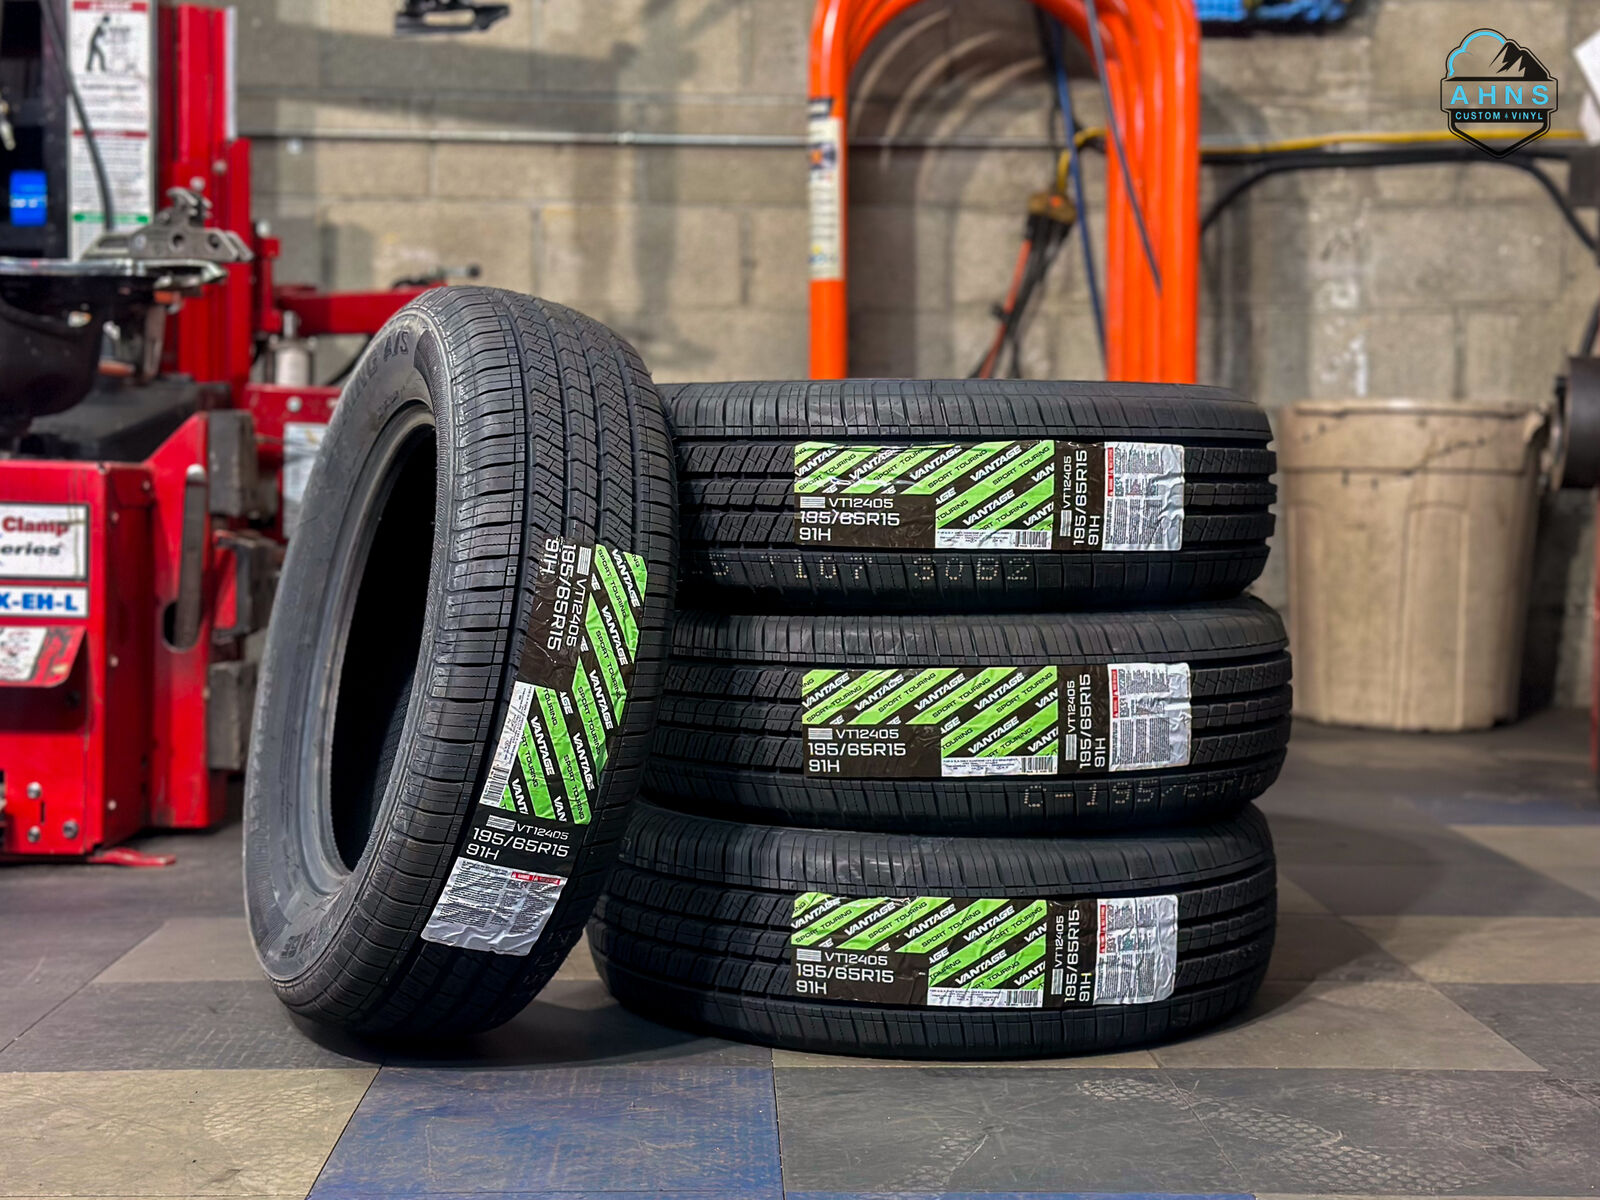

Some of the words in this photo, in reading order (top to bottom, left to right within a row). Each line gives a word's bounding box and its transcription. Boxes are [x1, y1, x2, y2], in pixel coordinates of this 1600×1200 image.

[799, 475, 823, 491] SPORT
[824, 453, 856, 475] TOURING
[873, 464, 898, 481] SPORT
[910, 445, 962, 480] VANTAGE
[928, 471, 953, 488] SPORT
[955, 449, 987, 471] TOURING
[970, 445, 1022, 482] VANTAGE
[993, 468, 1017, 485] SPORT
[1019, 446, 1050, 468] TOURING
[1063, 455, 1072, 509] VT12405
[1073, 450, 1088, 546] 195/65R15
[800, 510, 900, 526] 195/65R15
[828, 498, 893, 508] VT12405
[936, 499, 969, 521] TOURING
[962, 489, 1015, 526] VANTAGE
[995, 500, 1029, 523] TOURING
[2, 517, 69, 536] Clamp
[800, 528, 831, 541] 91H
[1088, 515, 1100, 545] 91H
[543, 538, 559, 575] 91H
[597, 549, 612, 577] SPORT
[610, 581, 628, 619] TOURING
[612, 549, 640, 607] VANTAGE
[547, 544, 576, 651] 195/65R15
[566, 579, 587, 647] VT12405
[595, 630, 609, 659] SPORT
[601, 605, 628, 665] VANTAGE
[578, 686, 590, 715] SPORT
[589, 669, 614, 730] VANTAGE
[802, 672, 850, 708] VANTAGE
[854, 674, 904, 711] VANTAGE
[878, 695, 902, 713] SPORT
[904, 673, 936, 695] TOURING
[914, 673, 966, 710] VANTAGE
[932, 700, 957, 718] SPORT
[958, 678, 990, 700] TOURING
[974, 672, 1025, 710] VANTAGE
[996, 695, 1020, 713] SPORT
[1022, 672, 1053, 695] TOURING
[1067, 681, 1076, 733] VT12405
[806, 707, 828, 722] SPORT
[1079, 674, 1092, 769] 195/65R15
[530, 715, 556, 776] VANTAGE
[808, 743, 906, 756] 195/65R15
[836, 729, 899, 739] VT12405
[941, 728, 974, 750] TOURING
[968, 716, 1019, 754] VANTAGE
[525, 751, 539, 788] TOURING
[563, 754, 576, 782] SPORT
[572, 732, 595, 791] VANTAGE
[809, 759, 840, 772] 91H
[1094, 738, 1106, 768] 91H
[472, 827, 570, 857] 195/65R15
[516, 824, 570, 841] VT12405
[466, 843, 500, 860] 91H
[795, 929, 819, 943] SPORT
[820, 909, 852, 930] TOURING
[844, 902, 896, 936] VANTAGE
[868, 922, 893, 939] SPORT
[895, 902, 927, 923] TOURING
[904, 903, 956, 939] VANTAGE
[921, 930, 947, 948] SPORT
[948, 909, 981, 932] TOURING
[963, 905, 1015, 941] VANTAGE
[985, 928, 1009, 946] SPORT
[1011, 906, 1043, 929] TOURING
[825, 952, 888, 966] VT12405
[1055, 915, 1064, 967] VT12405
[1064, 909, 1080, 1003] 195/65R15
[796, 963, 894, 983] 195/65R15
[955, 949, 1007, 985] VANTAGE
[987, 961, 1020, 982] TOURING
[796, 980, 827, 994] 91H
[1079, 973, 1092, 1002] 91H
